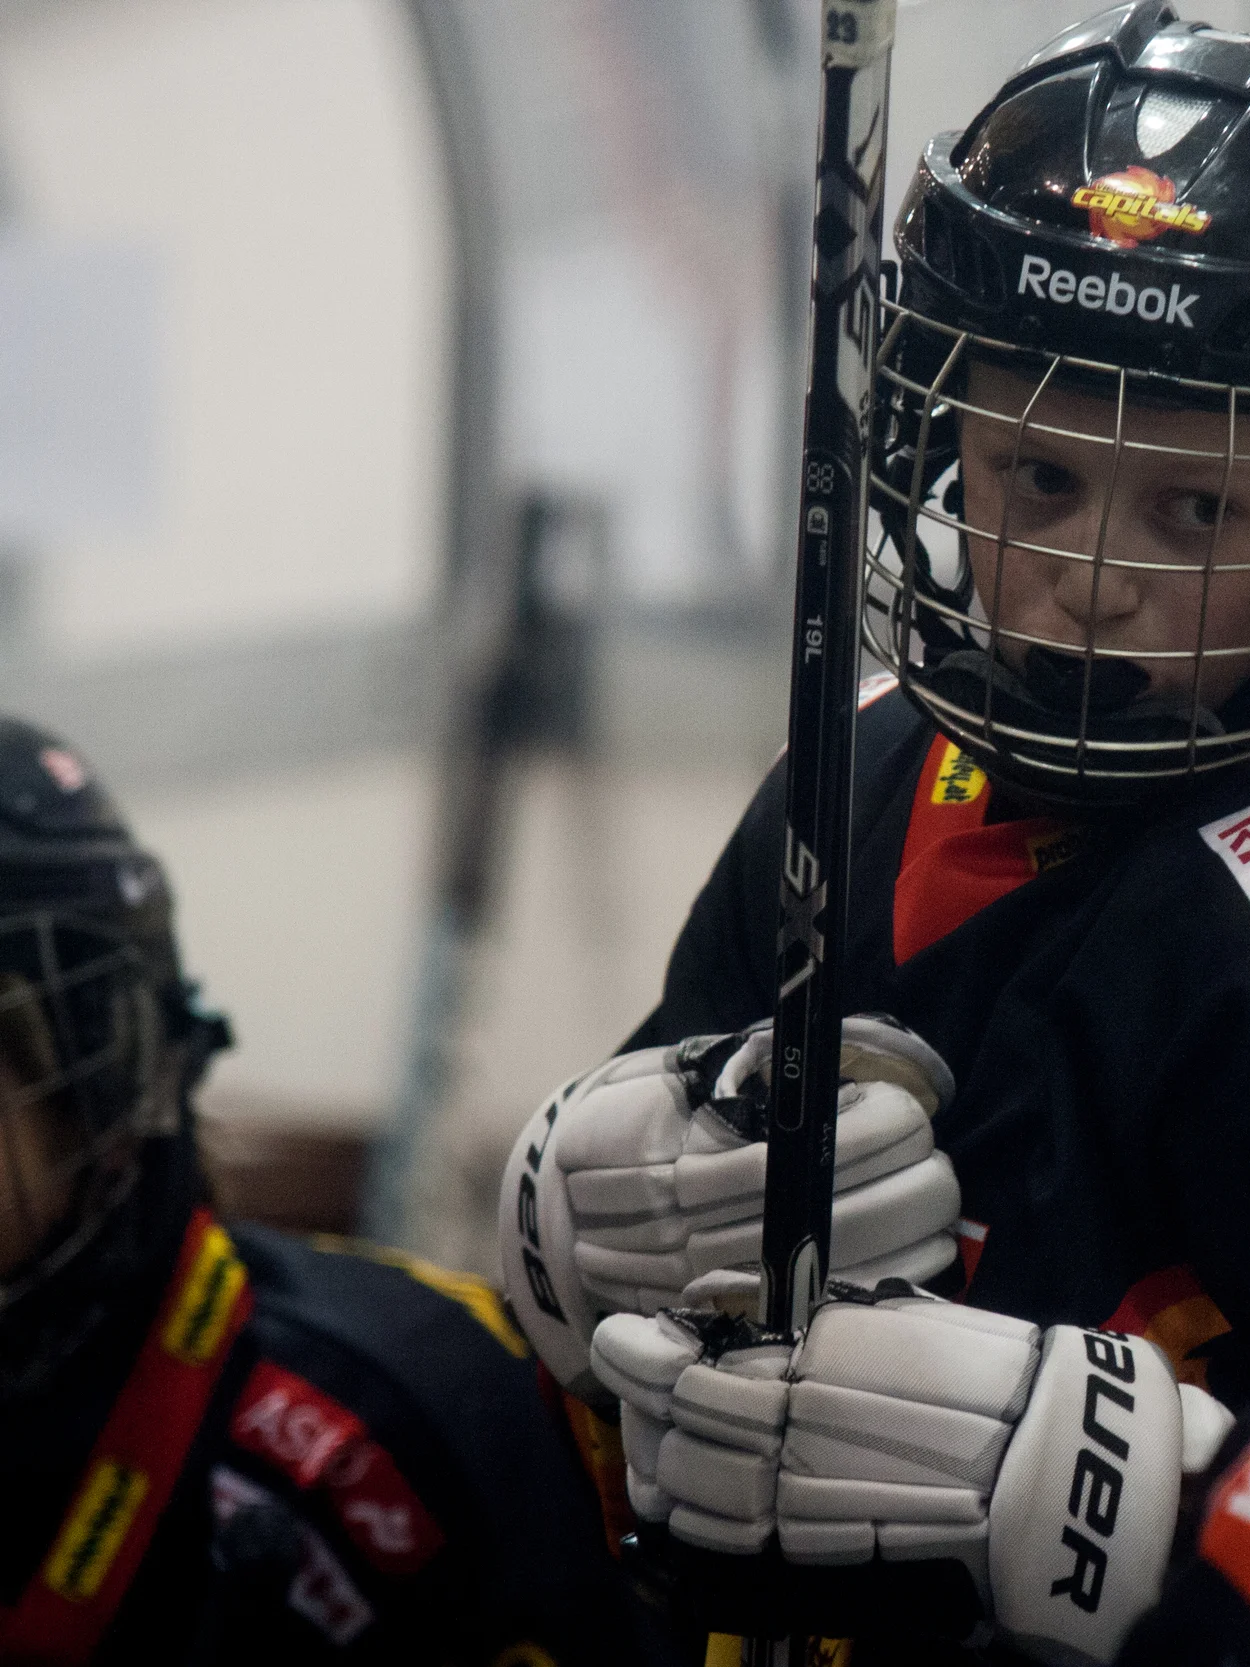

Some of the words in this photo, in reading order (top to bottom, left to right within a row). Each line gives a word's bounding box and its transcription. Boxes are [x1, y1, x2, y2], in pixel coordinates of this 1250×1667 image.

[1017, 254, 1199, 329] Reebok
[804, 614, 824, 664] 19L
[784, 1046, 800, 1079] 50
